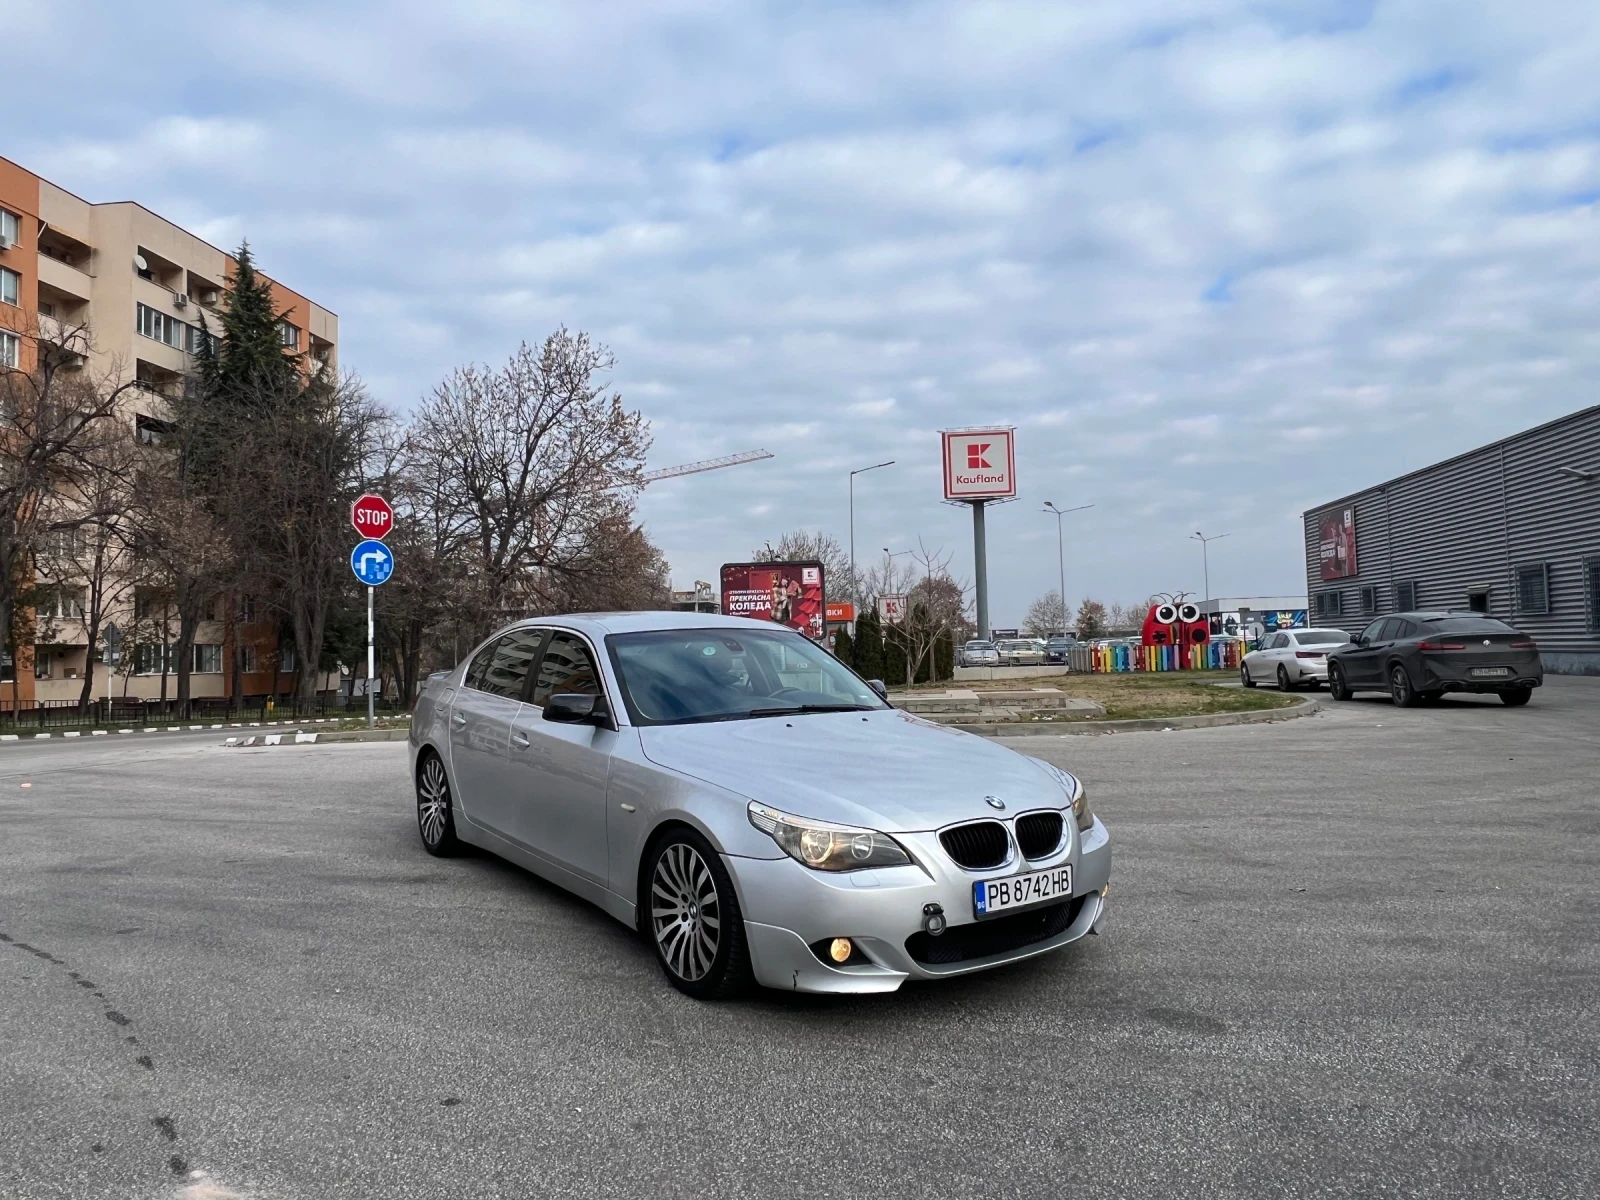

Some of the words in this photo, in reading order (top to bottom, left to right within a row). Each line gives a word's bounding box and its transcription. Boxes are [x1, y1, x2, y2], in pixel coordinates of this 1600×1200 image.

[956, 474, 1004, 484] Kaufland
[356, 508, 389, 526] STOP
[730, 594, 771, 602] ПРЕКРАСНА
[730, 601, 772, 612] КОЛЕДА
[988, 882, 1010, 908] PB
[1014, 874, 1050, 902] 8742
[1052, 870, 1069, 894] HB
